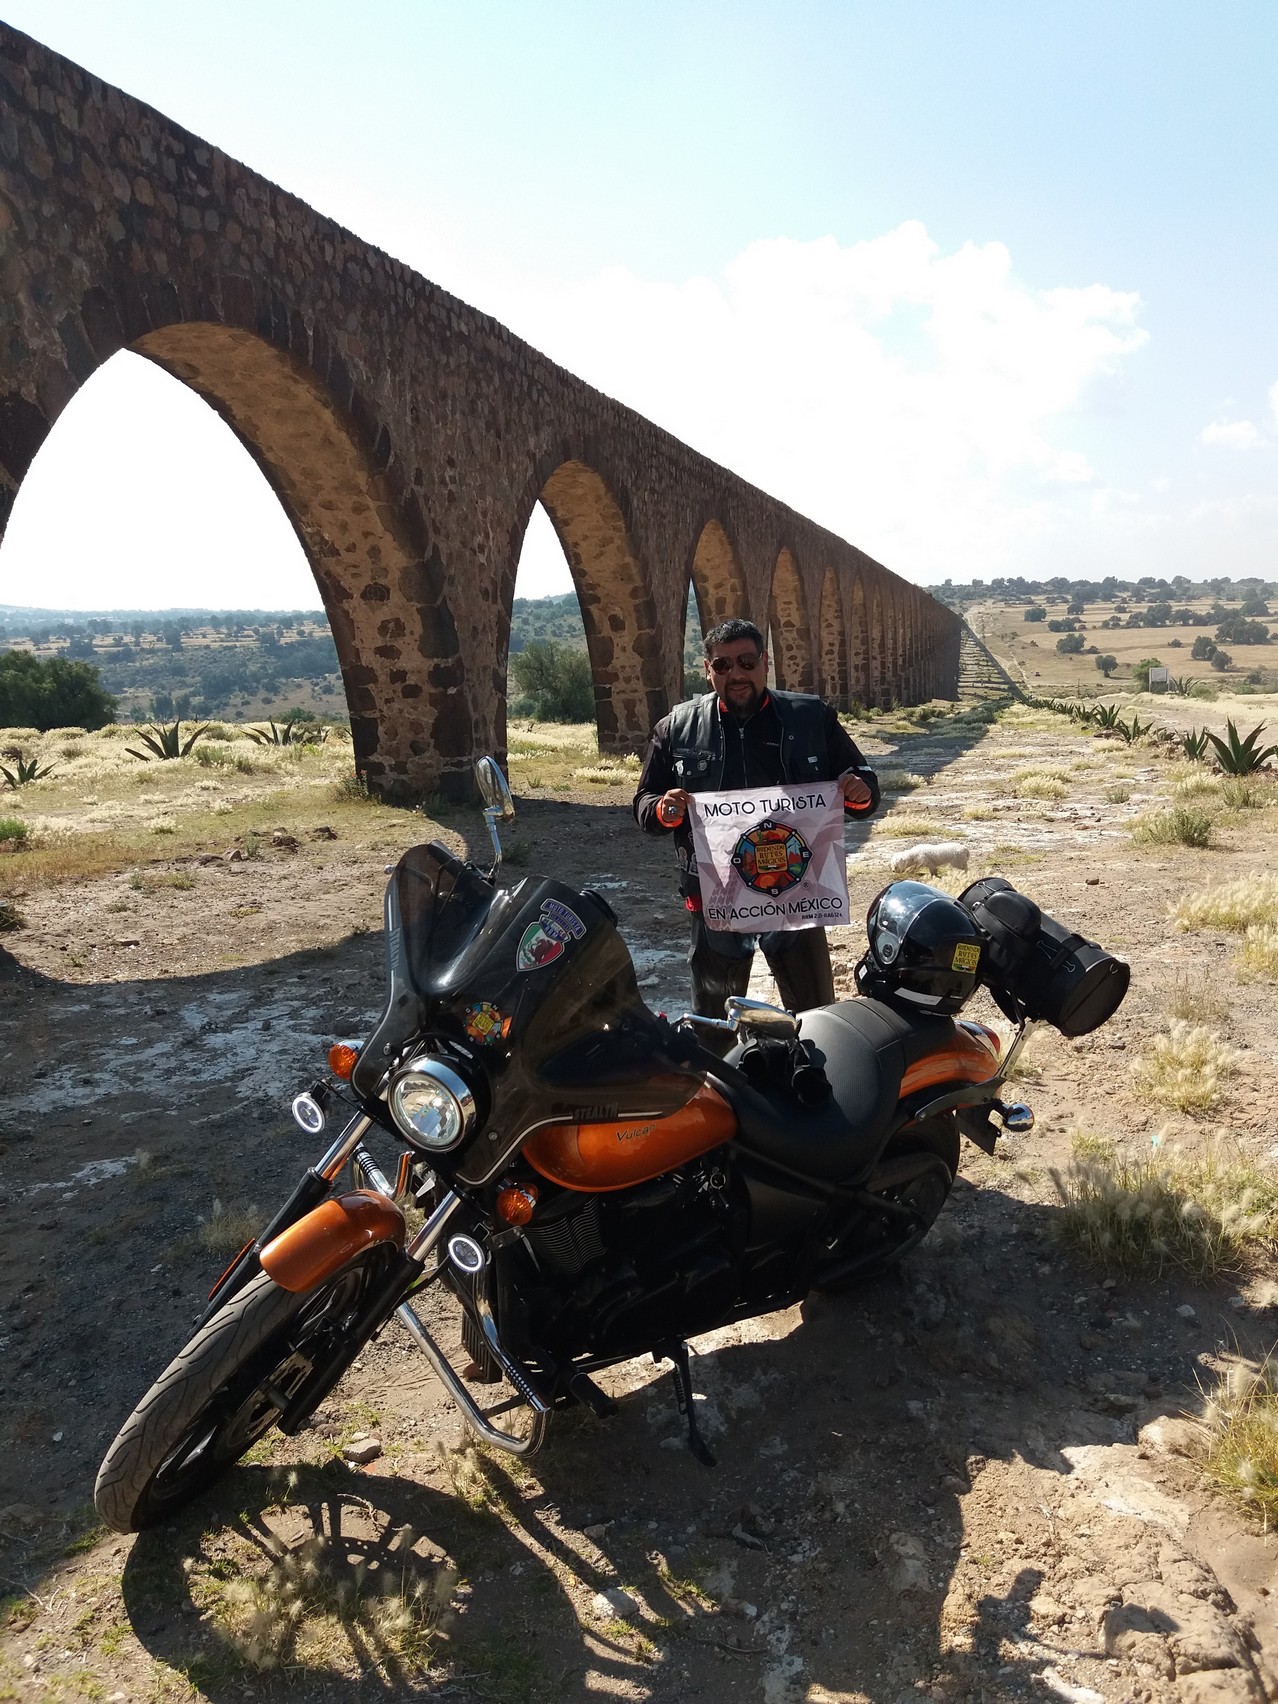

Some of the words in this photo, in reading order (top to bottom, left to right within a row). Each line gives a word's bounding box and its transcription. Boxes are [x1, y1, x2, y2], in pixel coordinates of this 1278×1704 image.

[704, 801, 756, 818] MOTO
[759, 793, 827, 813] TURISTA
[708, 908, 726, 920] EN
[730, 901, 786, 920] ACCIÓN
[788, 897, 843, 914] MÉXICO
[574, 1102, 619, 1120] STEALTH
[616, 1123, 656, 1142] Vulcan
